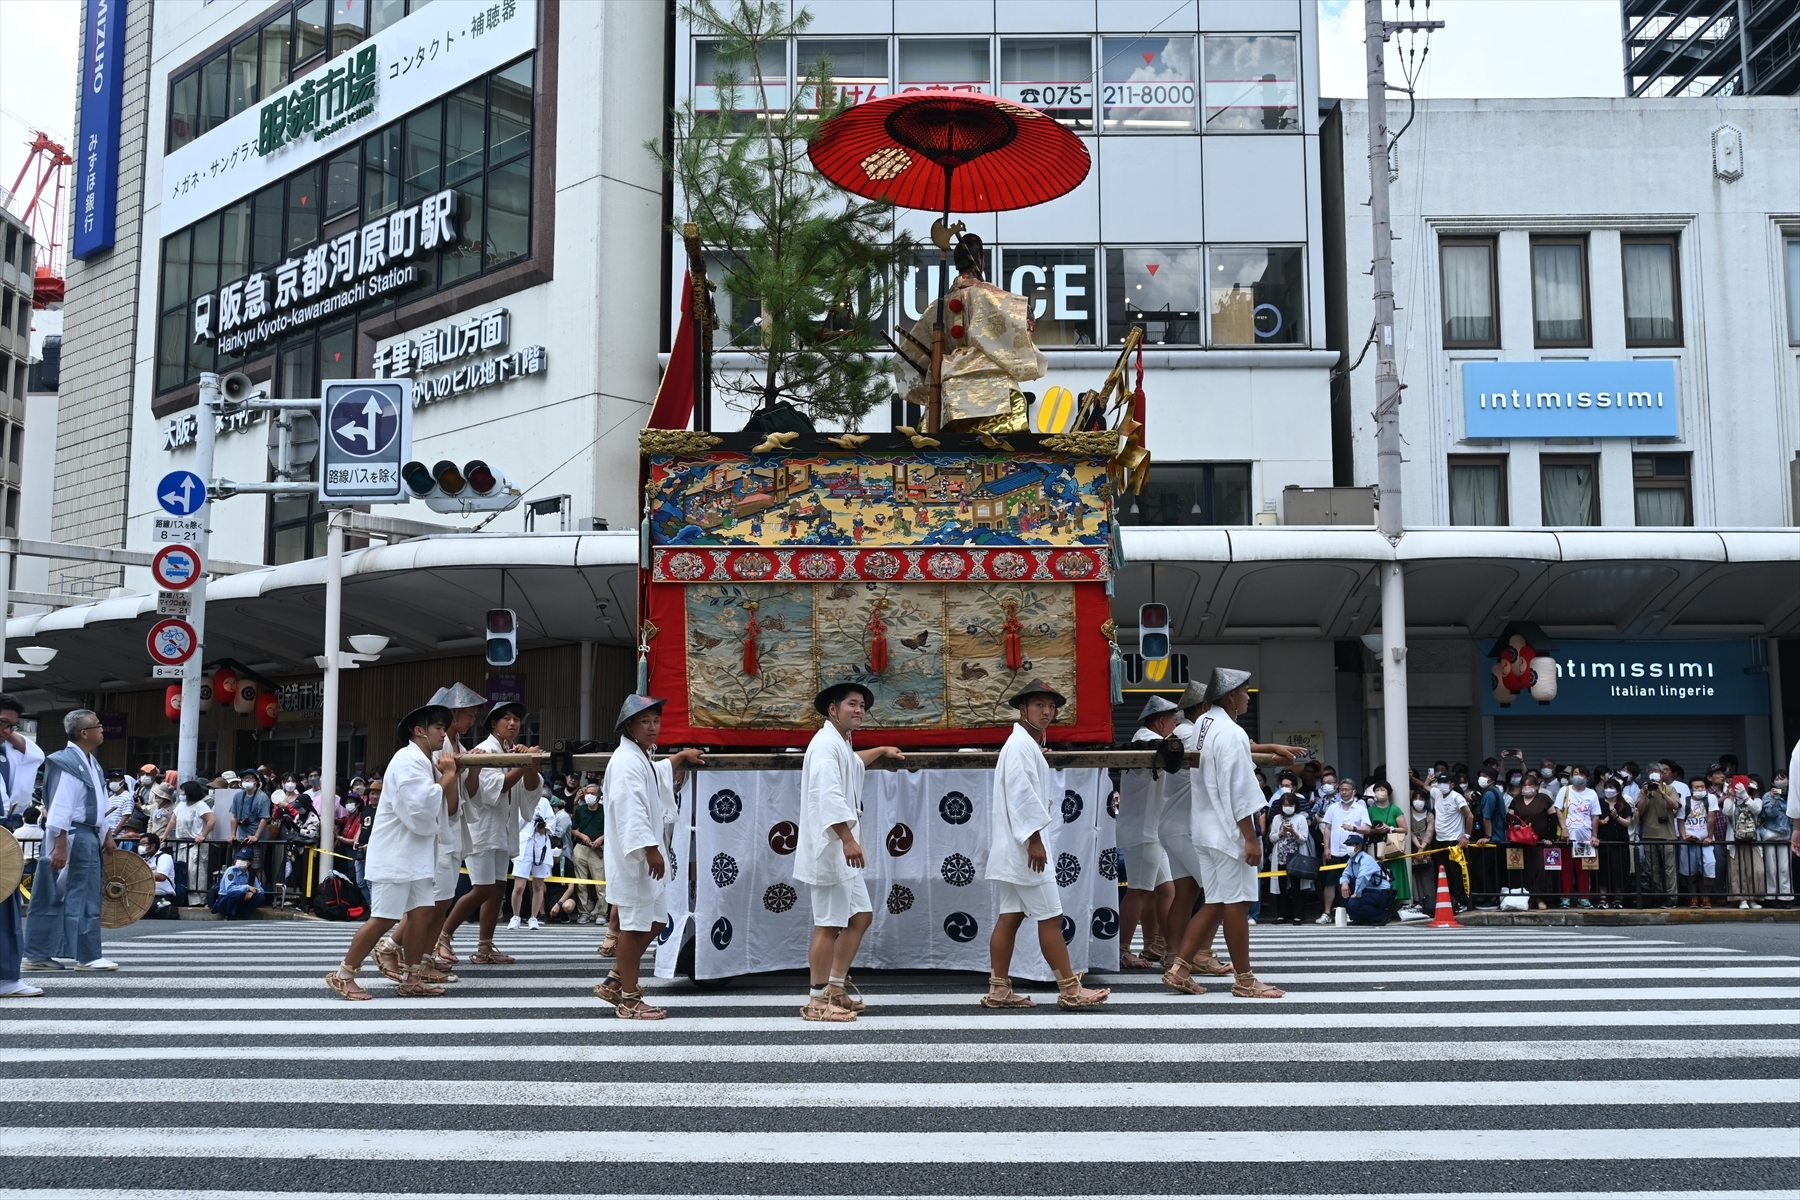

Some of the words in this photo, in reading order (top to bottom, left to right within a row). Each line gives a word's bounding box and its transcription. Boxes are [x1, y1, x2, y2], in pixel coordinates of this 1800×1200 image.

[258, 43, 377, 157] 眼鏡市場
[313, 117, 347, 142] MEGANE
[347, 102, 375, 124] ICHIBA
[84, 134, 98, 234] みずほ銀行
[172, 138, 259, 200] メガネ・サングラス
[218, 272, 267, 333] 阪急
[274, 189, 453, 309] 京都河原町駅
[218, 328, 256, 356] Hankyu
[256, 279, 365, 341] Kyoto-kawaramachi
[368, 266, 412, 297] Station
[1481, 389, 1664, 408] intimissimi
[328, 469, 397, 484] 路線バスを除く
[155, 519, 203, 530] 路線バスを除く
[1611, 685, 1655, 696] Italian
[1660, 685, 1714, 699] lingerie
